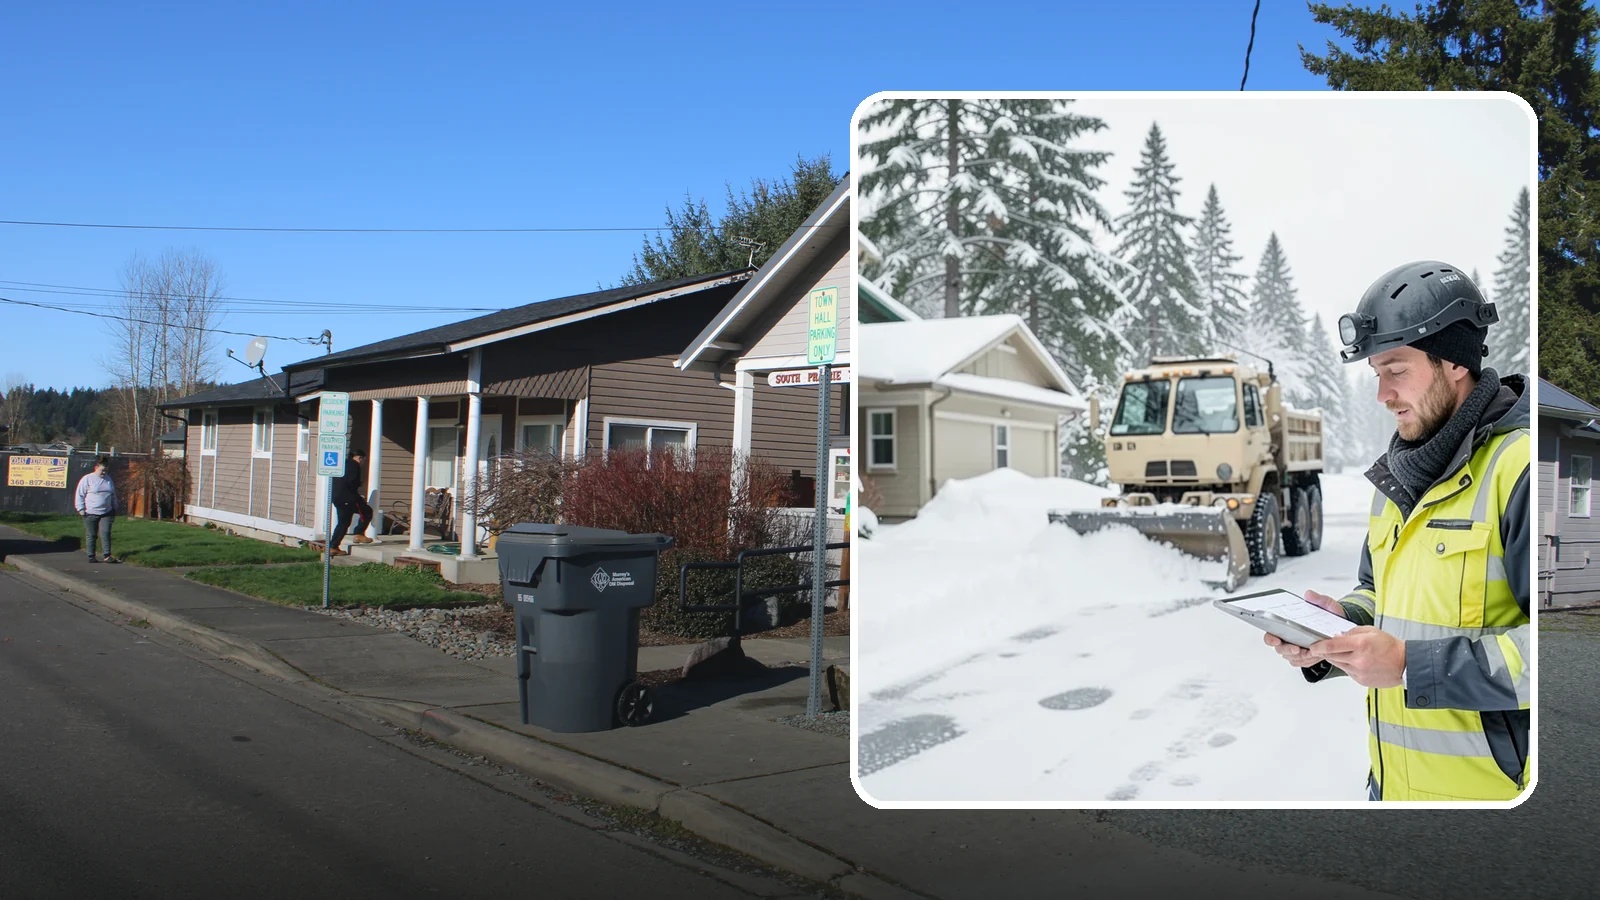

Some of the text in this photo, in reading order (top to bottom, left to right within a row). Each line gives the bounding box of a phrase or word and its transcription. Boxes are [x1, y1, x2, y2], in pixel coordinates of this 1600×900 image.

[815, 295, 833, 308] TOWN
[814, 312, 831, 324] HALL
[810, 327, 835, 340] PARKING
[814, 344, 831, 357] ONLY
[775, 373, 801, 384] SOUTH
